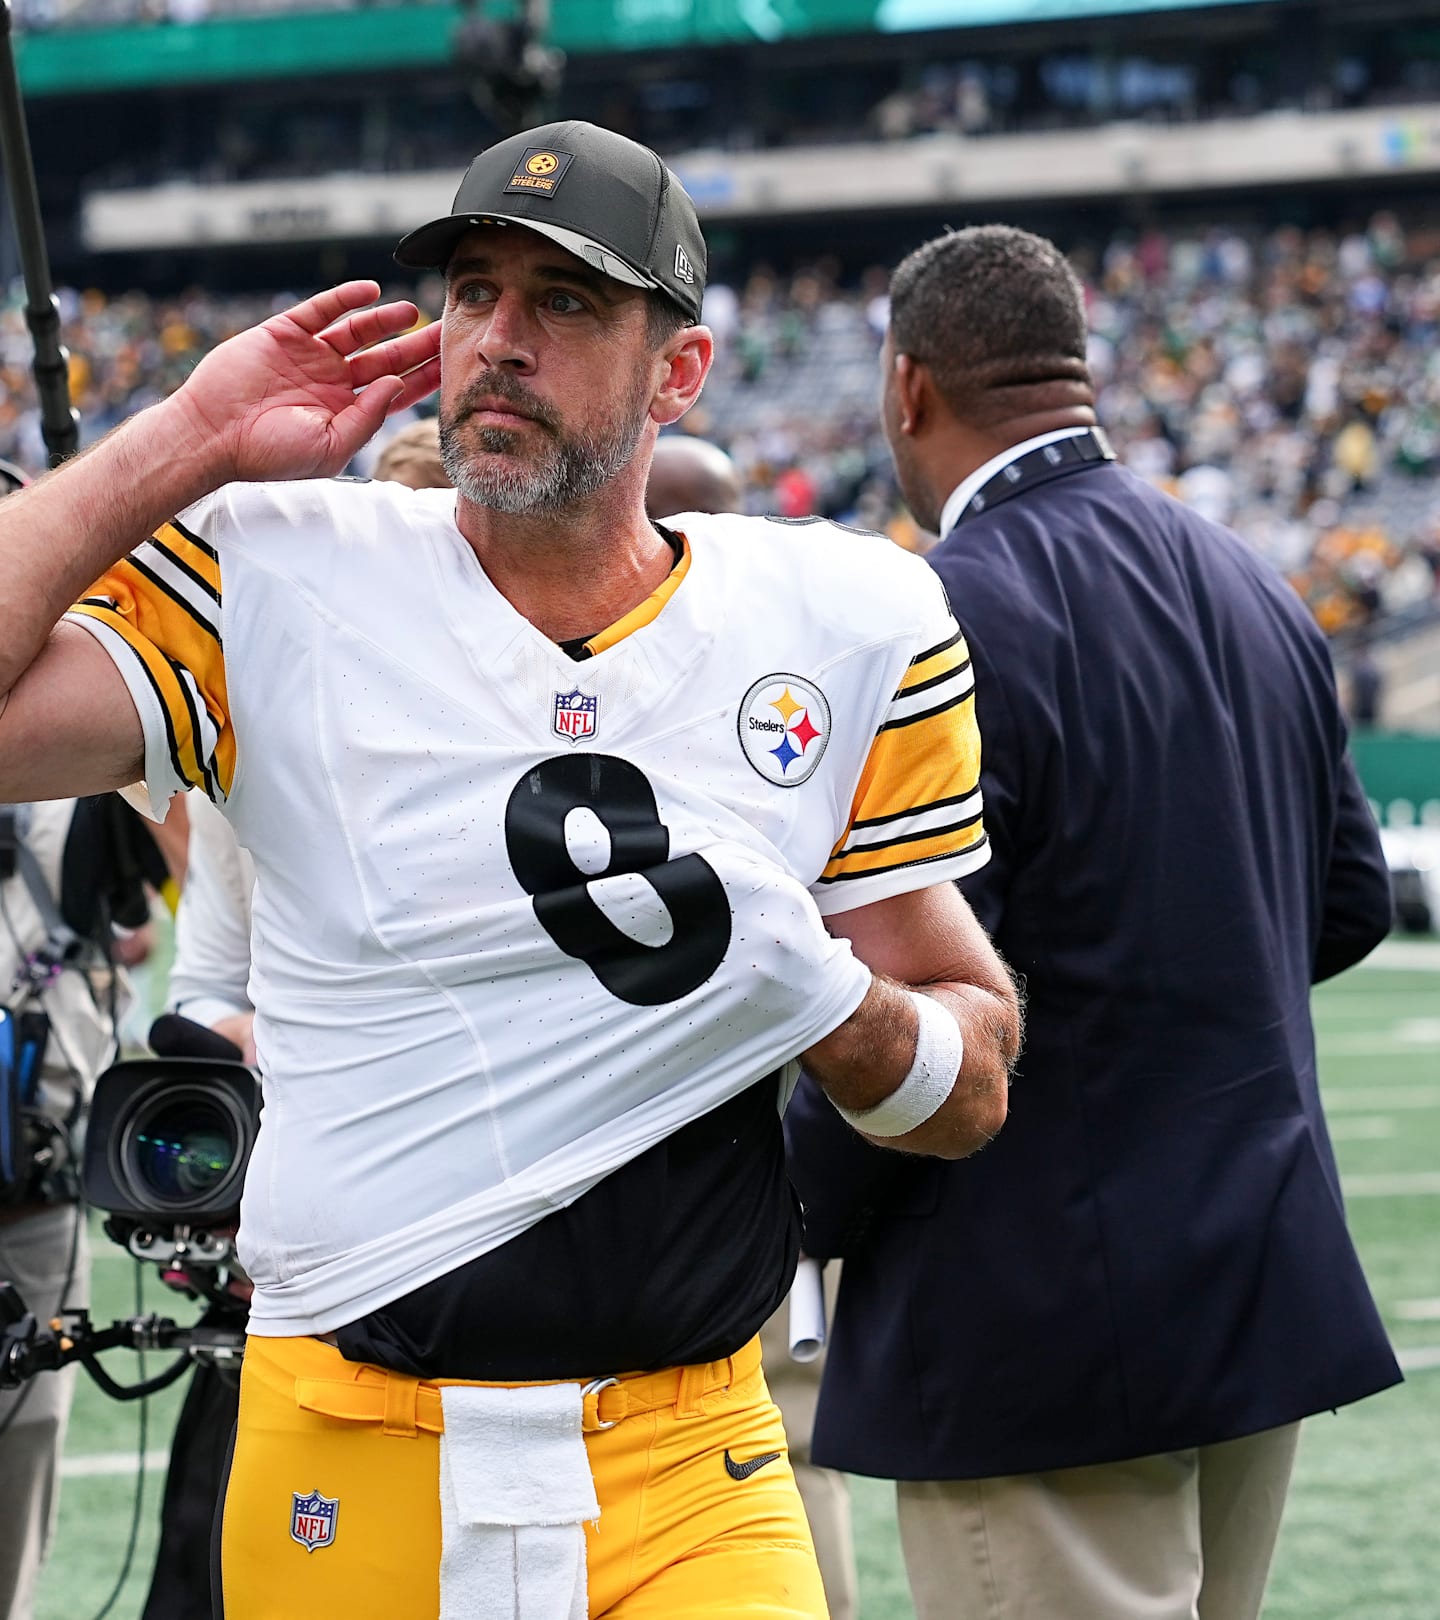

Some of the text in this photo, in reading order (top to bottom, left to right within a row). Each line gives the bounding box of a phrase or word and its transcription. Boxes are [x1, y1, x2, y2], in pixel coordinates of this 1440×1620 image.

[511, 179, 553, 190] STEELERS
[558, 711, 592, 736] NFL
[749, 717, 785, 733] Steelers
[504, 752, 732, 1006] 8
[296, 1516, 327, 1540] NFL
